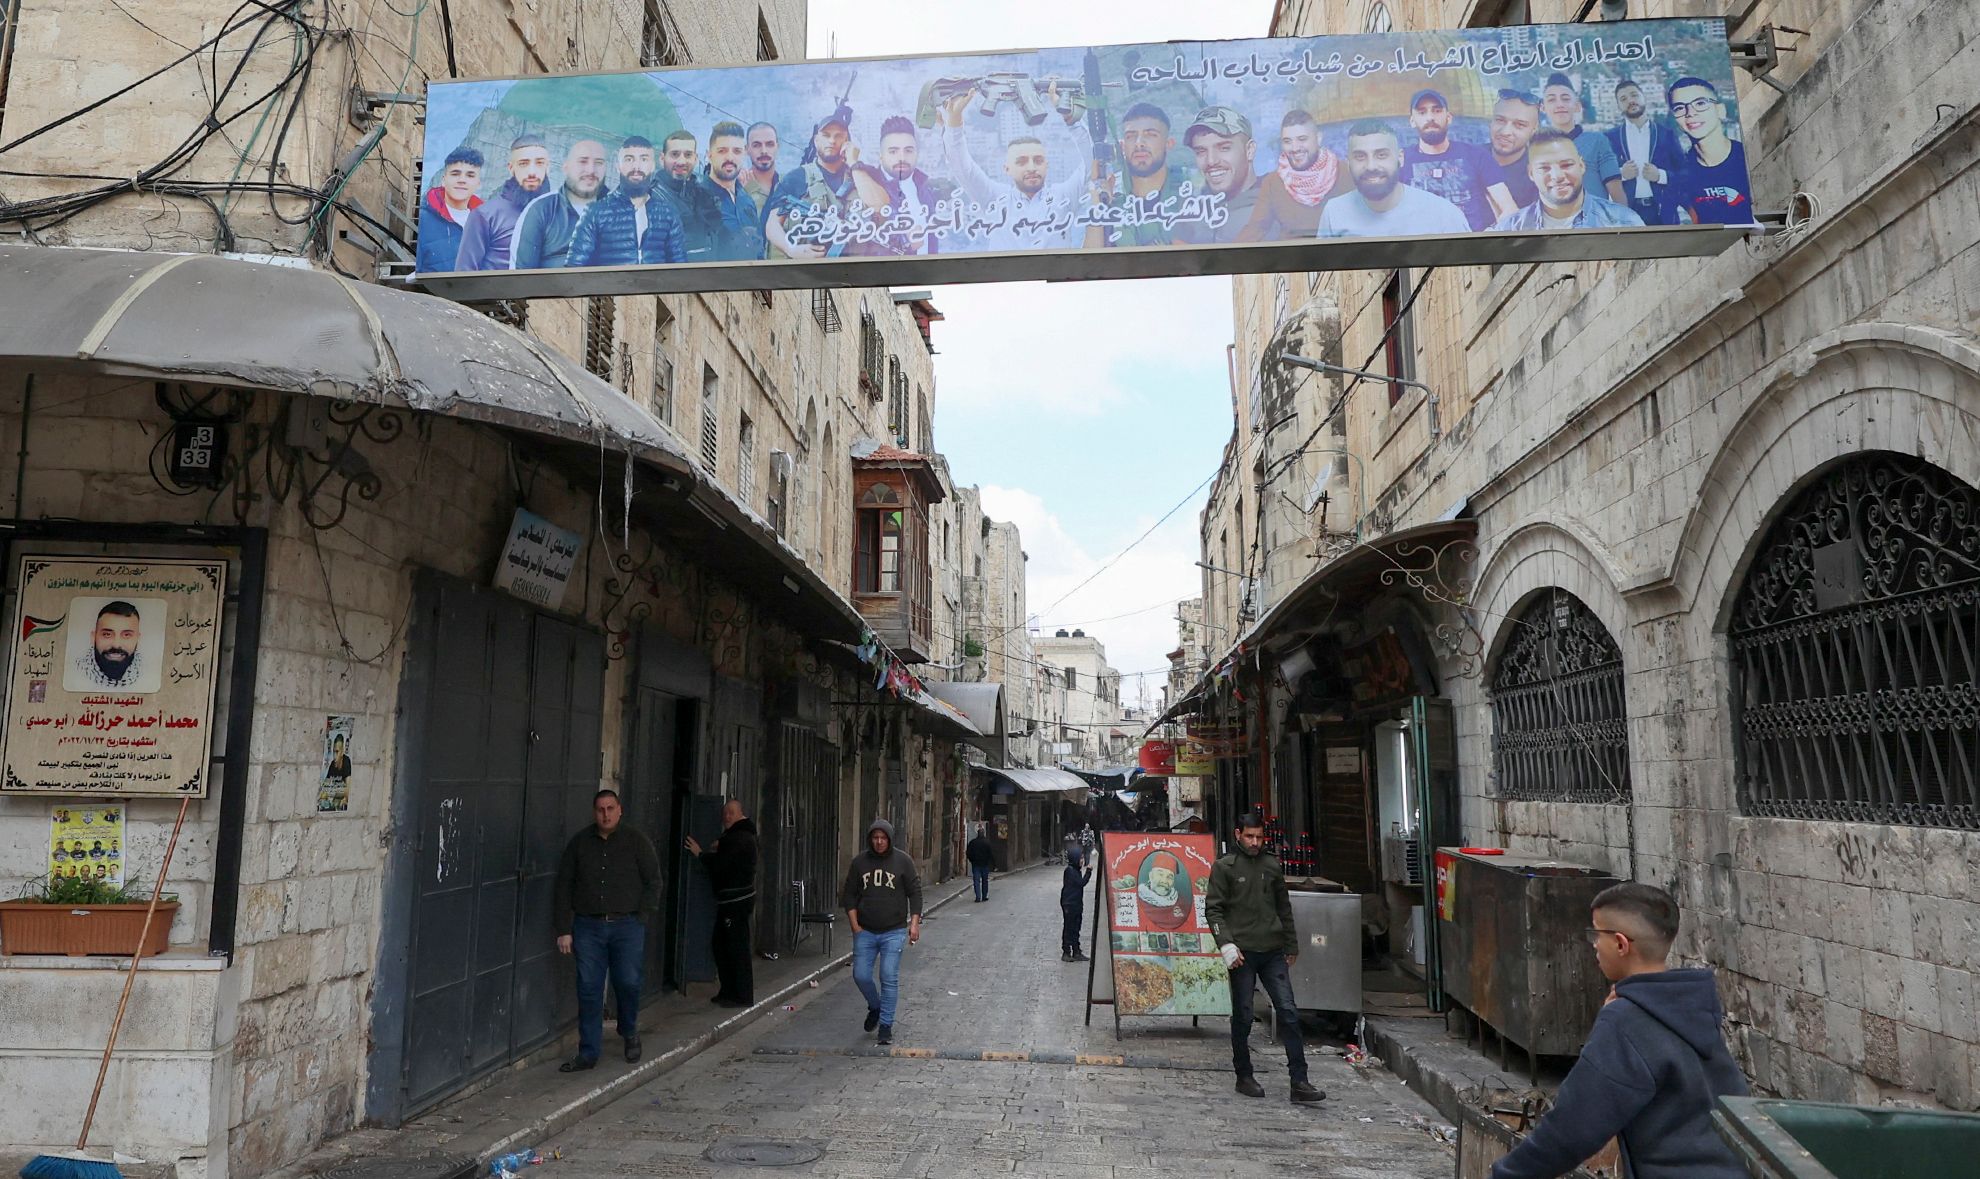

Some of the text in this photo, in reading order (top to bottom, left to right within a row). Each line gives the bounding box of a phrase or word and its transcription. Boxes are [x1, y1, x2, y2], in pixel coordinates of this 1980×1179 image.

[1388, 45, 1475, 77] الشهداء
[1480, 40, 1547, 75] ارواح
[1223, 52, 1271, 85] باب
[1276, 48, 1344, 83] شباب
[1347, 54, 1383, 78] من
[1704, 186, 1726, 197] THE
[175, 612, 212, 634] مجموعات
[24, 641, 55, 658] أصدقاء
[173, 642, 207, 656] عرين
[24, 661, 52, 678] الشهيد
[81, 695, 143, 707] الشهيد المشتبك
[127, 709, 162, 728] أحمد
[165, 714, 198, 728] محمد
[107, 736, 129, 748] بتاريخ
[131, 736, 157, 747] استشهد
[82, 751, 109, 760] لنصرته
[137, 753, 159, 761] العرين
[61, 760, 82, 769] بتكبير
[83, 761, 105, 770] الجميع
[128, 772, 137, 780] ولا
[139, 772, 153, 781] يوما
[1184, 845, 1212, 870] مصنع
[862, 869, 896, 890] FOX
